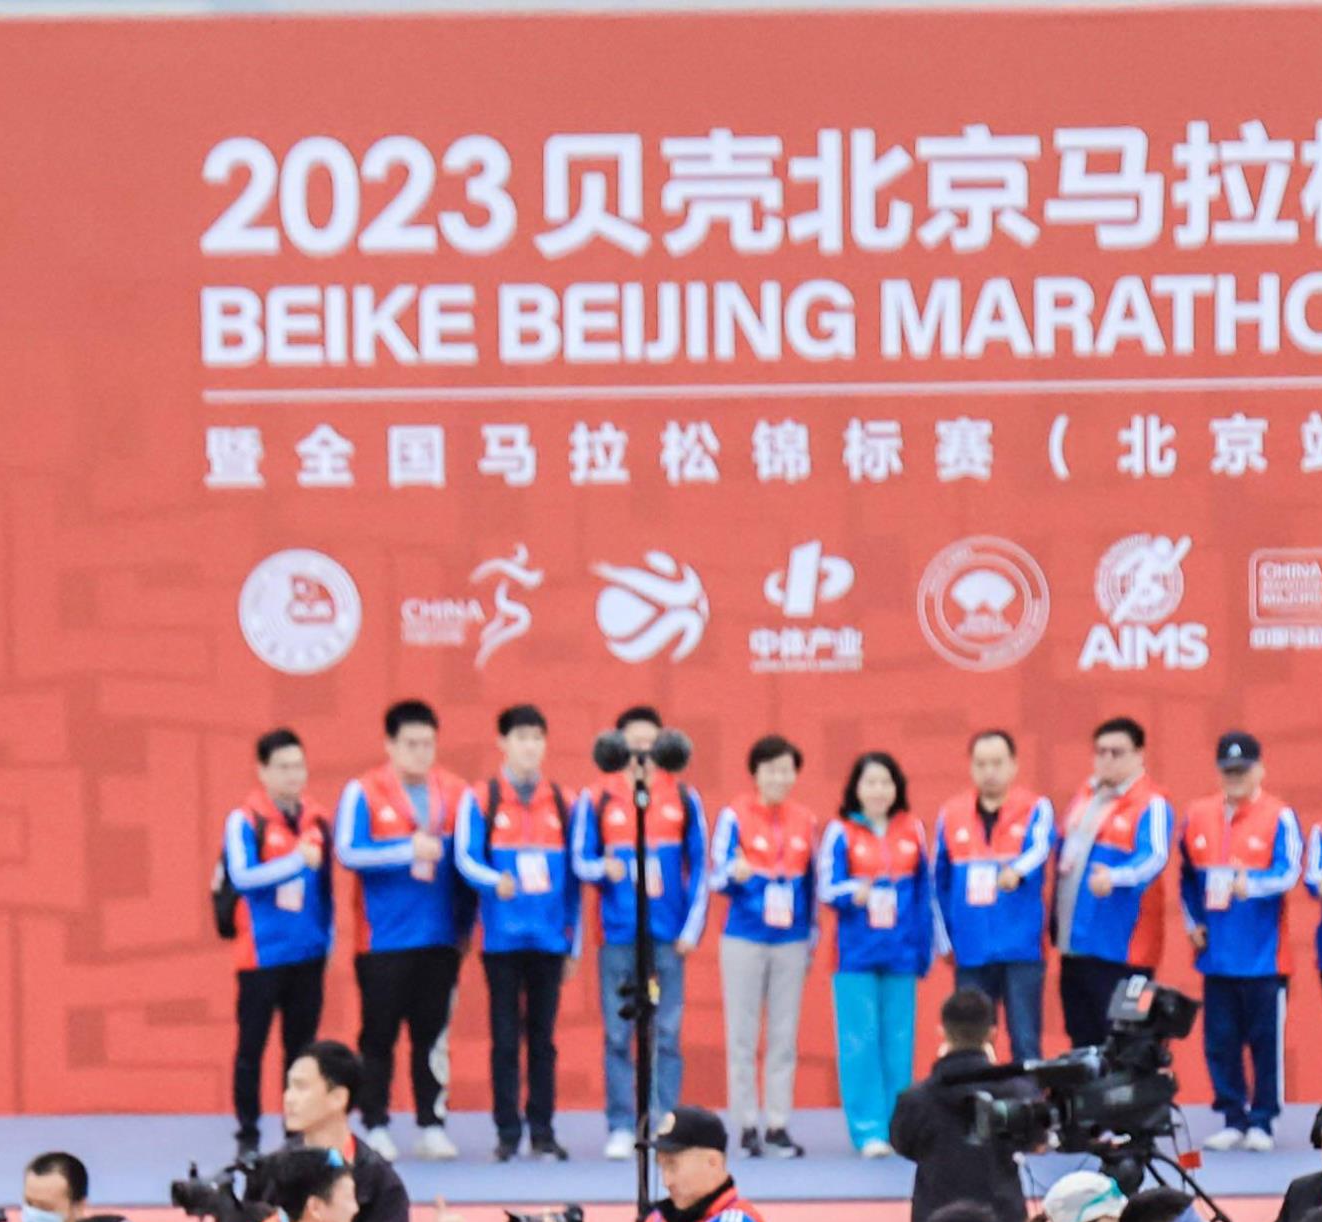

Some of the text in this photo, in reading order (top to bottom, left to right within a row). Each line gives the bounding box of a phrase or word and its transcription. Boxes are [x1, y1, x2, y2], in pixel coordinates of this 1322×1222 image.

[200, 284, 478, 367] BEIKE
[498, 280, 856, 364] BEIJING
[1078, 623, 1210, 670] AIMS
